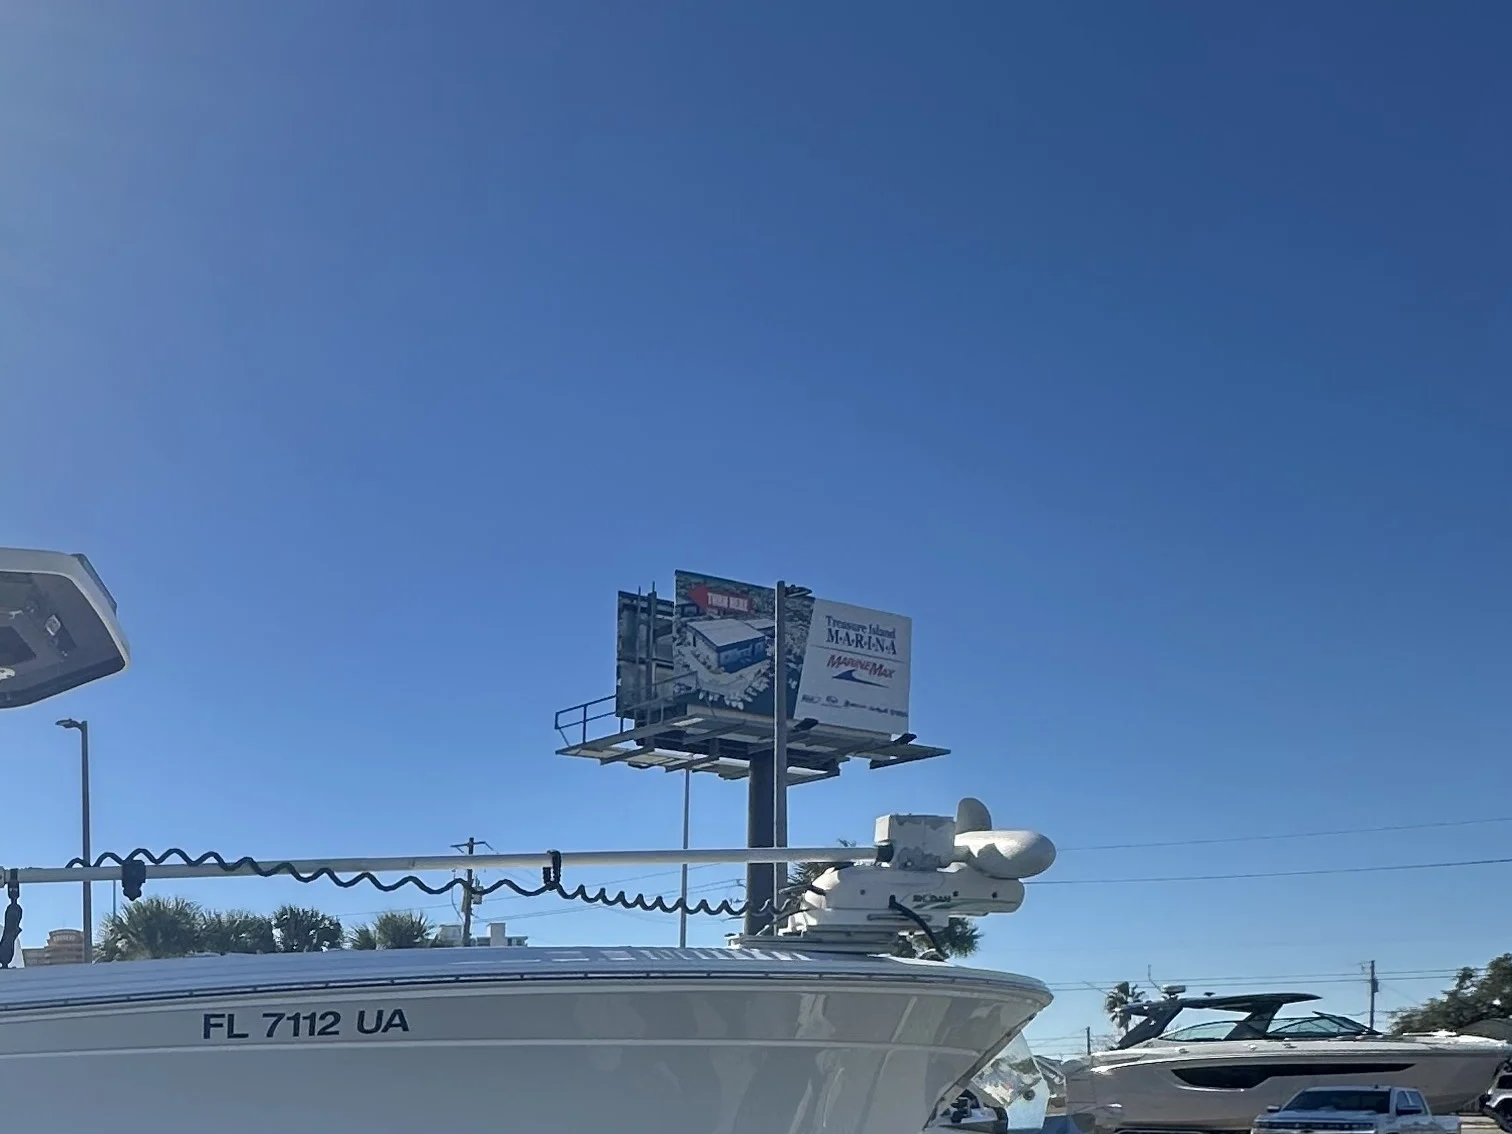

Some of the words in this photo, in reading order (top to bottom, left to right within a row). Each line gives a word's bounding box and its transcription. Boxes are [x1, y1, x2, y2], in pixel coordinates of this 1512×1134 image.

[826, 615, 867, 634] Treasure
[868, 623, 896, 639] Island
[203, 1013, 249, 1040] FL
[262, 1010, 341, 1038] 7112
[356, 1008, 410, 1035] UA
